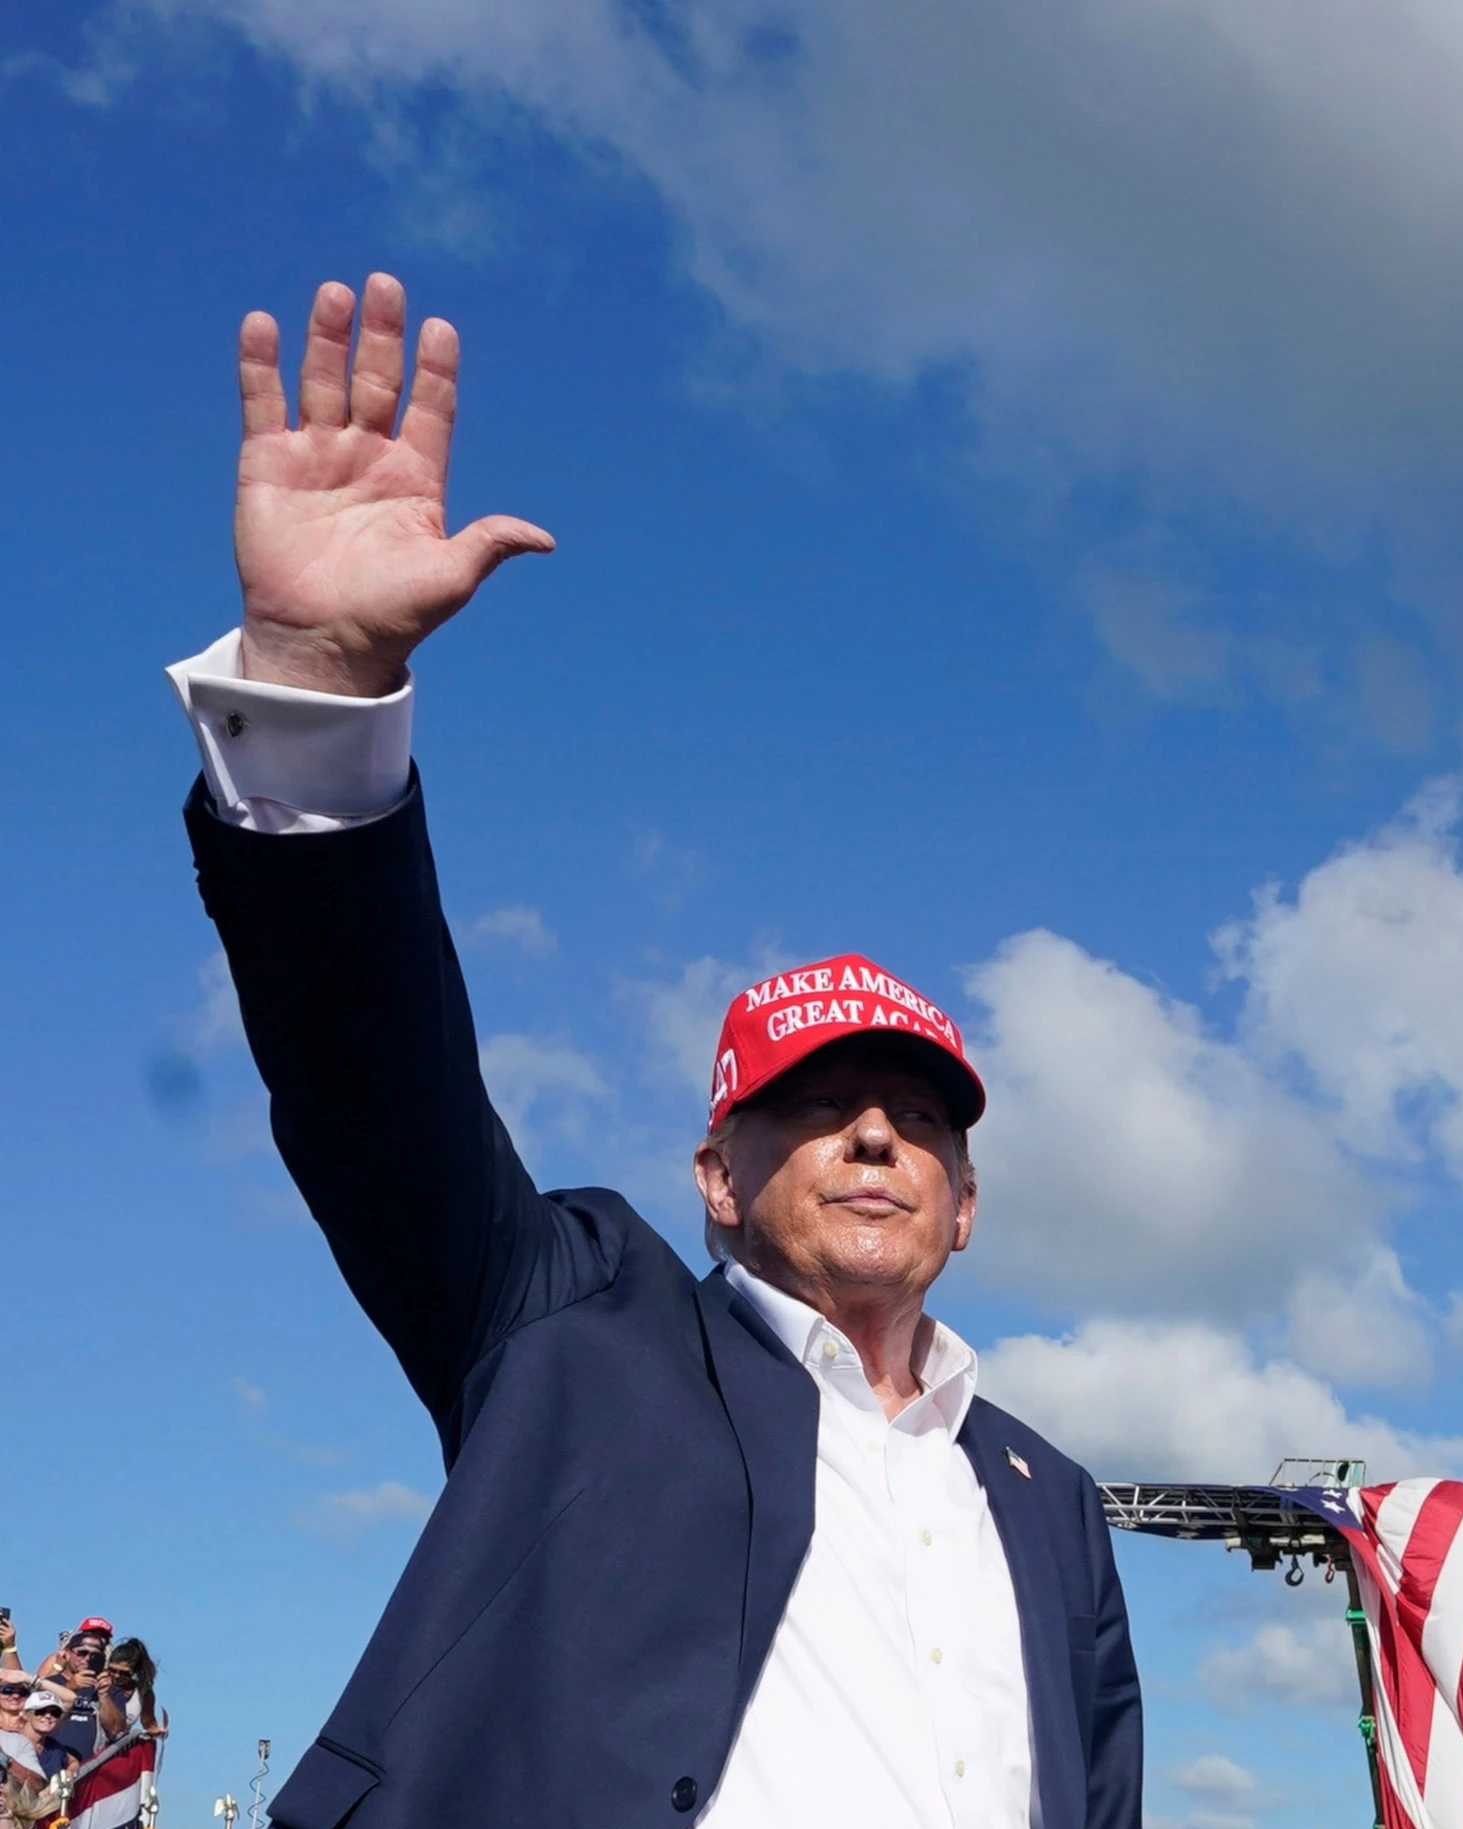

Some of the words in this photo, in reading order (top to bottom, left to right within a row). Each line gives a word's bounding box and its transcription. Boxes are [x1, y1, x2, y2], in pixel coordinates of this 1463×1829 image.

[745, 967, 834, 1012] MAKE
[837, 965, 957, 1048] AMERICA
[767, 999, 864, 1041] GREAT
